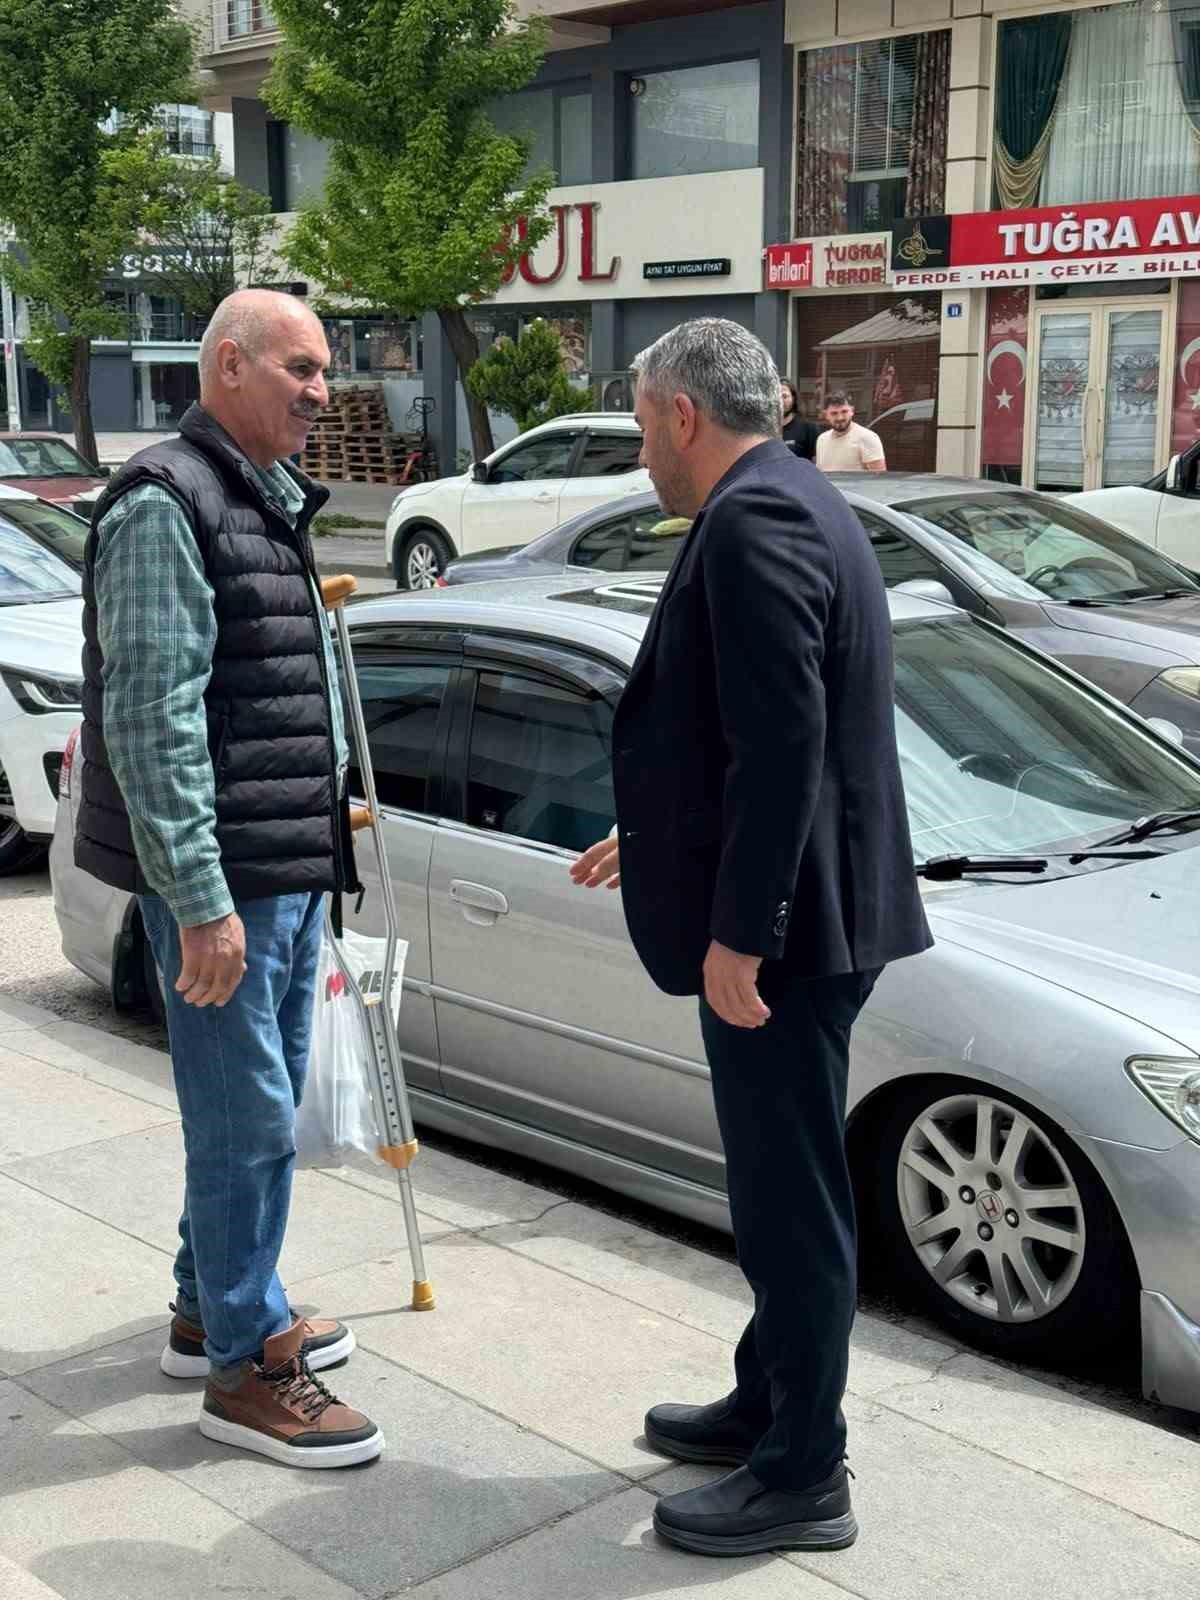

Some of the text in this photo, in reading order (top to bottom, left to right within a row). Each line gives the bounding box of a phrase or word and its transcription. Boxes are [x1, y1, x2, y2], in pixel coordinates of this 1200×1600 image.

[998, 211, 1140, 257] TUĞRA
[677, 263, 703, 274] UYGUN
[769, 249, 811, 282] brillant
[895, 272, 961, 286] PERDE
[980, 268, 1030, 281] HALI
[1050, 260, 1119, 280] ÇEYİZ
[1143, 258, 1200, 274] BİLL
